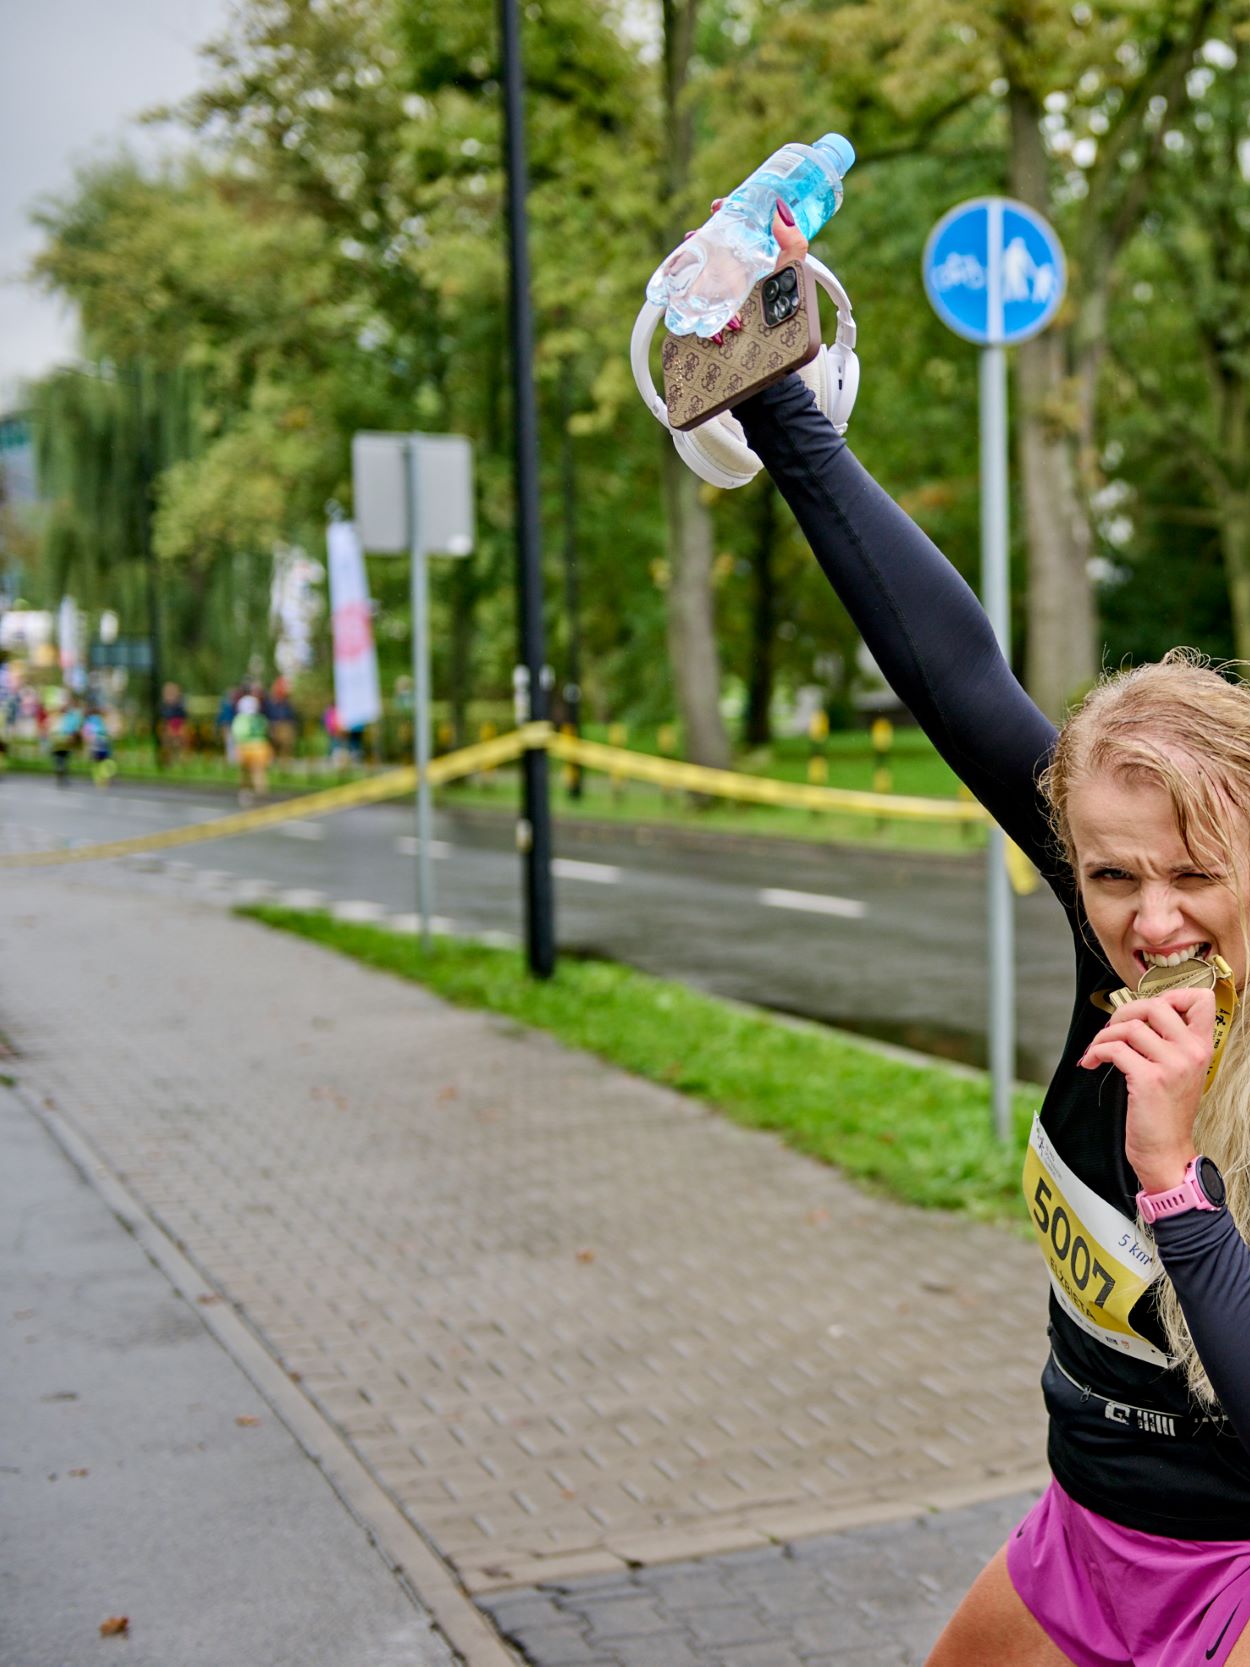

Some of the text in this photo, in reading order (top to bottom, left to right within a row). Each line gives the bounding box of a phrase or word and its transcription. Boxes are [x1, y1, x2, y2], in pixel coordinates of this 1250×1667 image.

[1033, 1177, 1116, 1309] 5007
[1118, 1233, 1151, 1266] 5 km
